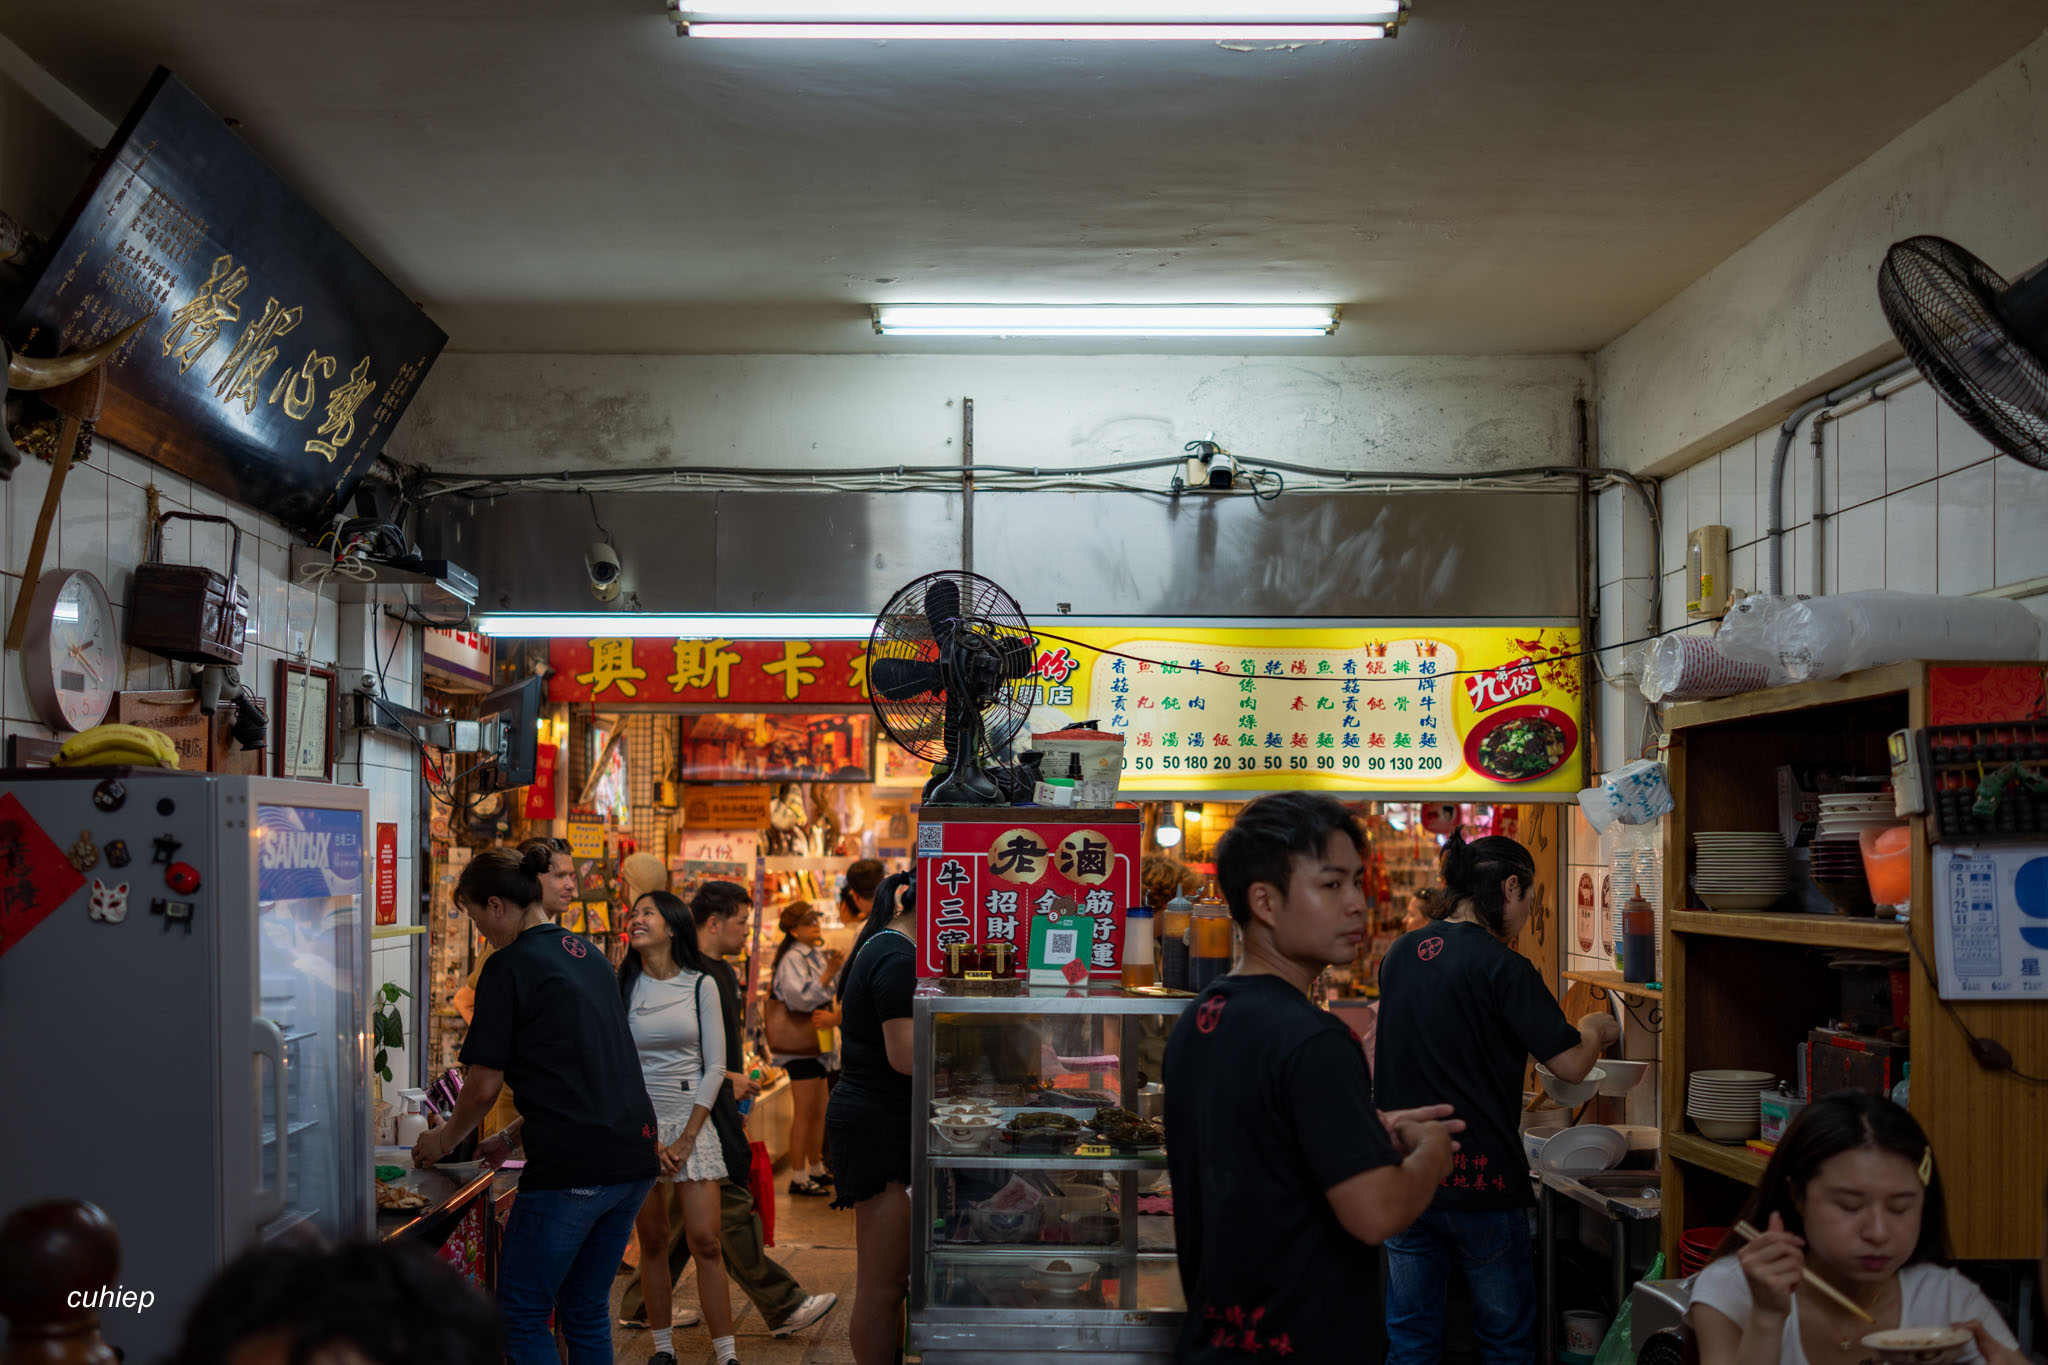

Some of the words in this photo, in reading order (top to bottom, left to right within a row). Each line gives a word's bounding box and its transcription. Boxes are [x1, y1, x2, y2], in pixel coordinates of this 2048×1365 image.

[1136, 659, 1155, 748] 魚丸湯
[1160, 660, 1181, 748] 餛飩湯
[1187, 659, 1206, 748] 牛肉湯
[1212, 660, 1232, 747] 白飯
[1264, 659, 1284, 748] 乾麵
[1290, 659, 1309, 749] 陽春麵
[1315, 659, 1335, 749] 魚丸麵
[1341, 658, 1361, 749] 香菇貢丸麵
[1366, 660, 1387, 749] 餛飩麵
[1392, 659, 1413, 749] 排骨麵
[1418, 659, 1439, 749] 招牌牛肉麵
[1468, 673, 1537, 714] 九份
[1135, 757, 1154, 770] 50
[1163, 756, 1181, 769] 50
[1184, 756, 1208, 769] 180
[1213, 756, 1231, 769] 20
[1238, 757, 1256, 770] 30
[1264, 756, 1282, 769] 50
[1290, 756, 1308, 769] 50
[1317, 756, 1335, 769] 90
[1342, 755, 1360, 769] 90
[1368, 757, 1386, 770] 90
[1389, 757, 1413, 770] 130
[1418, 757, 1442, 770] 200
[263, 830, 332, 870] SANLUX
[989, 835, 1108, 877] 老滷
[1083, 888, 1117, 969] 筋好運
